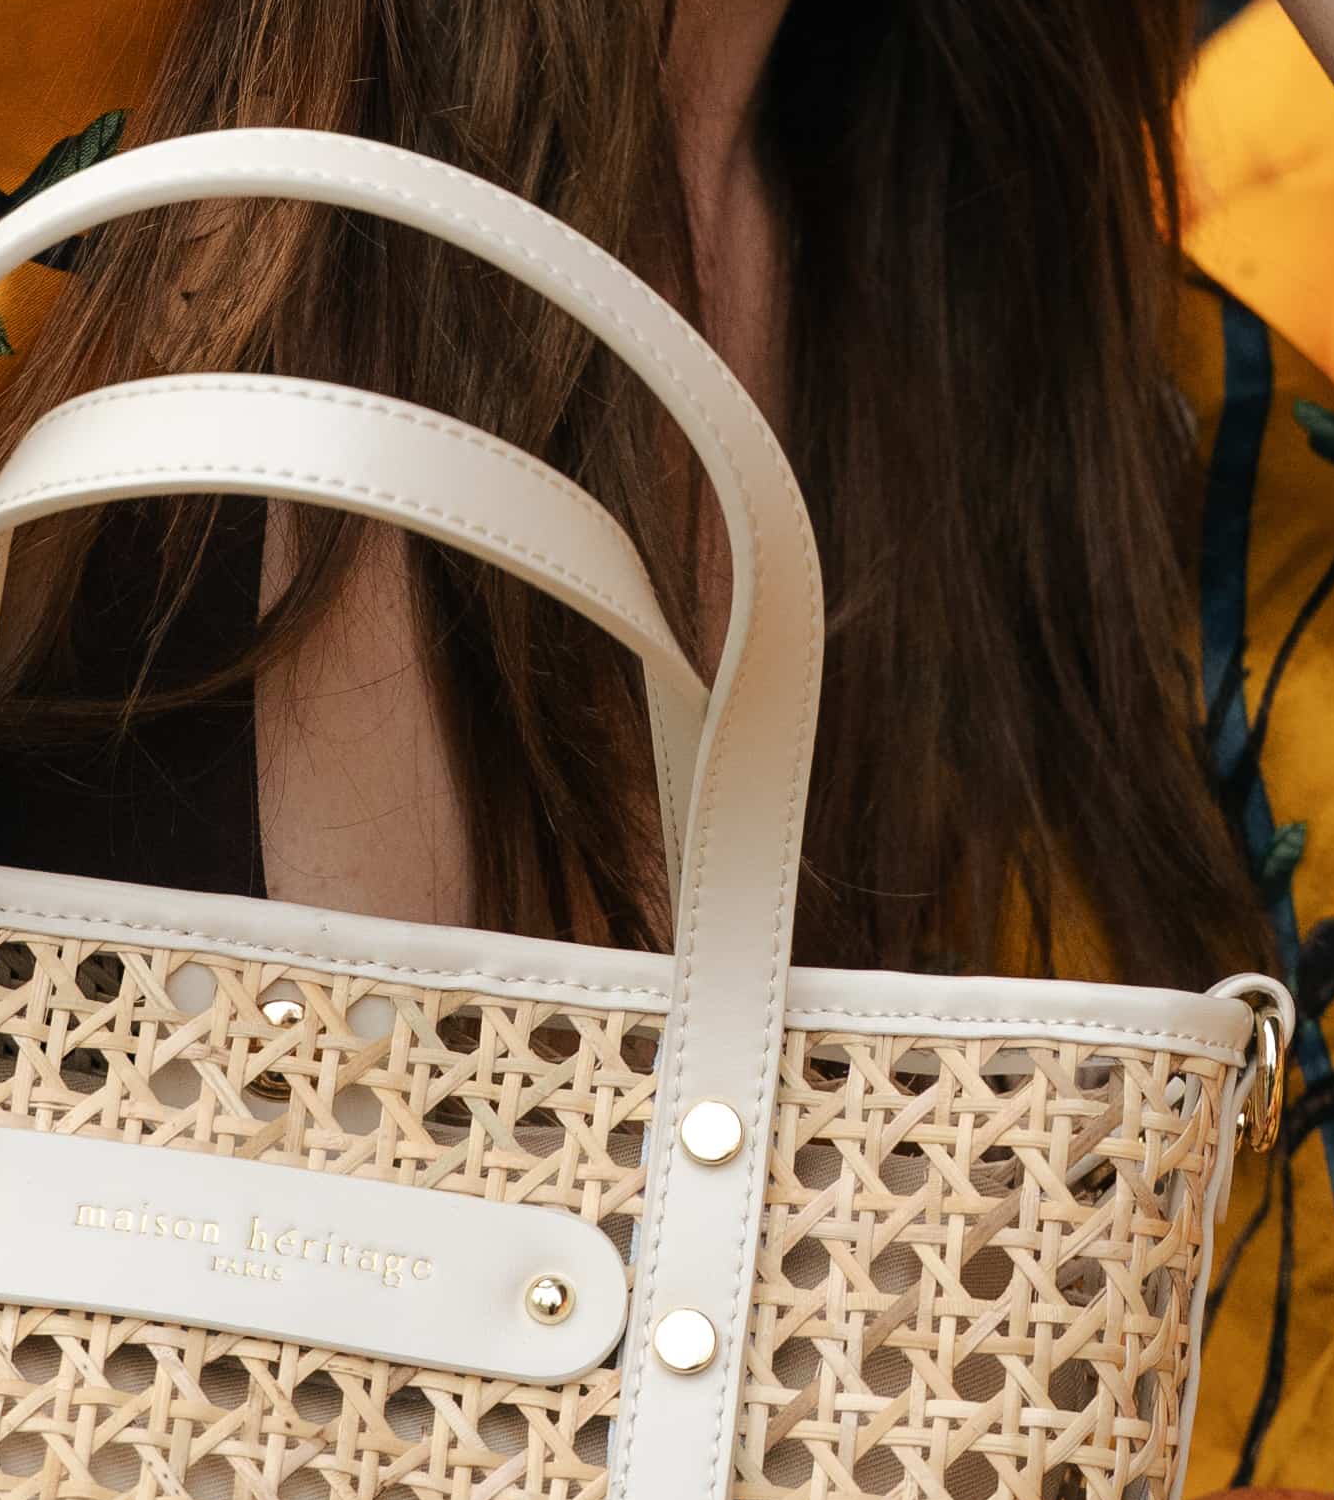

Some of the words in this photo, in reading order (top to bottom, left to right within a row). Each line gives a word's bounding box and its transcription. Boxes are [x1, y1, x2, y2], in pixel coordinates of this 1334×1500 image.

[74, 1199, 220, 1245] maison
[247, 1215, 433, 1288] héritage
[209, 1254, 283, 1281] PARIS
